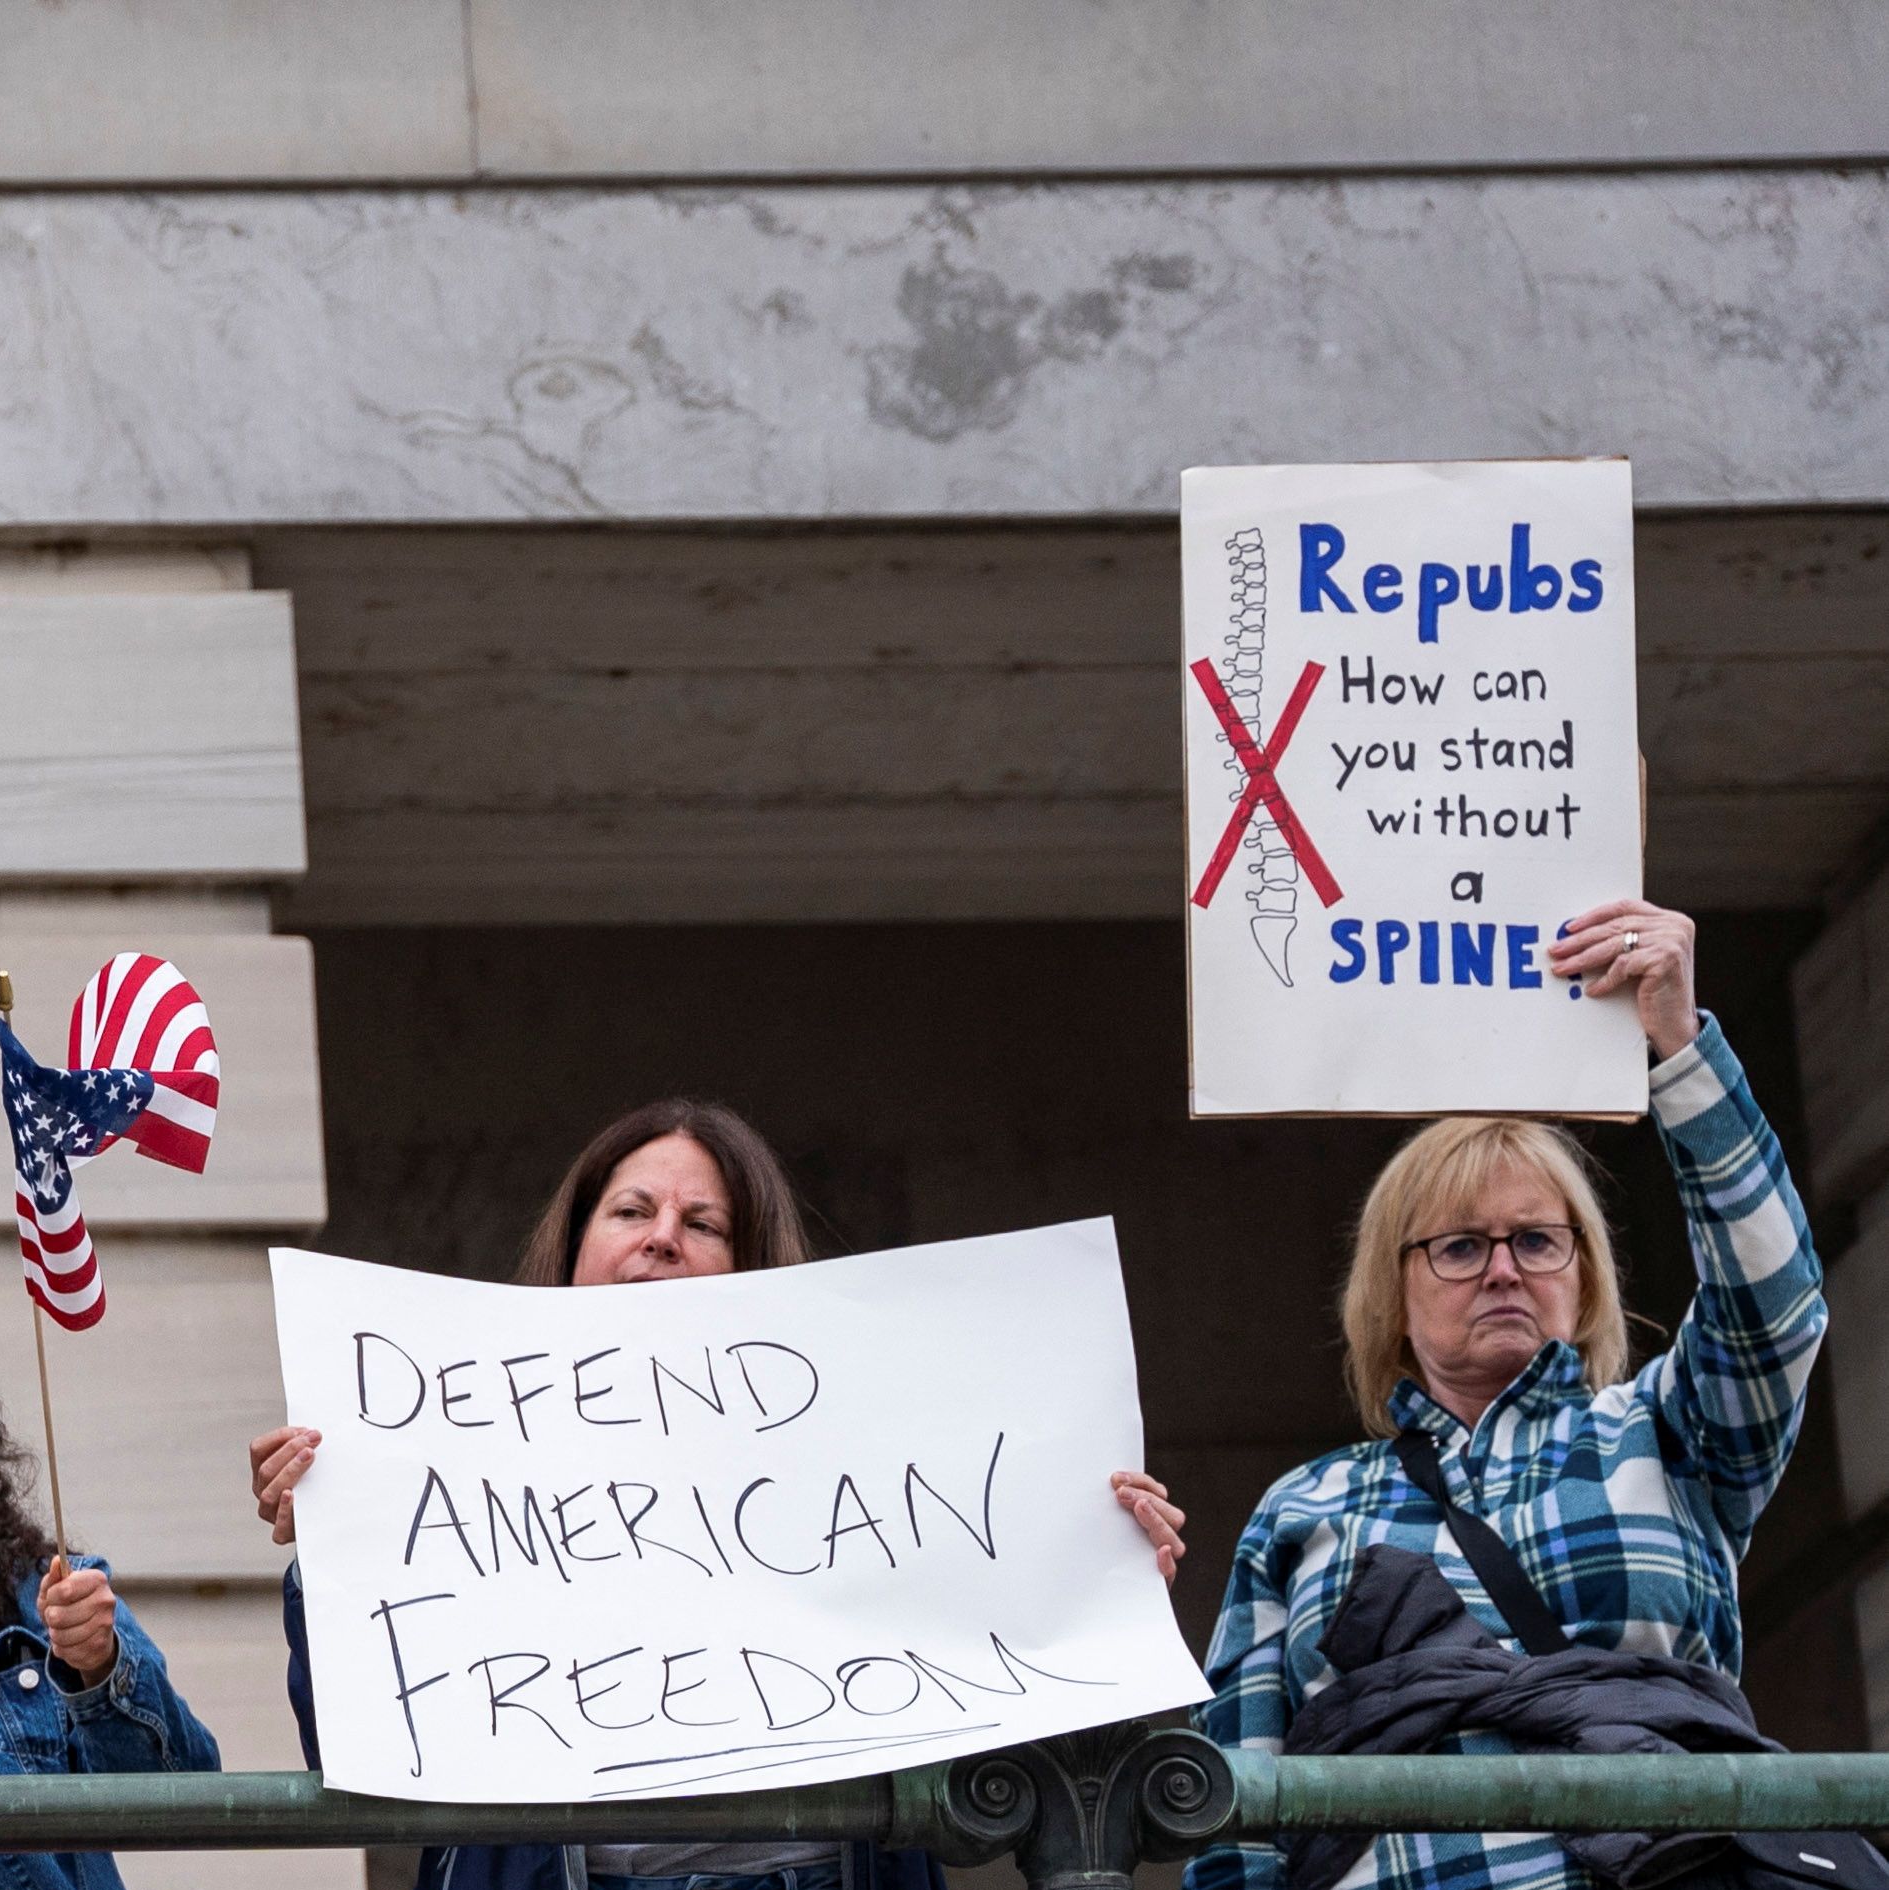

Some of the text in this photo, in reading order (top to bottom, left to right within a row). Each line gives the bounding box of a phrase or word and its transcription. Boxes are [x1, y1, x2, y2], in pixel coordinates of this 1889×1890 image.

[1299, 523, 1603, 643] Repubs
[1340, 655, 1547, 704] How can
[1331, 720, 1575, 791] you stand
[1366, 793, 1581, 839] without
[1450, 870, 1484, 902] a
[353, 1331, 819, 1441] DEFEND
[405, 1431, 1003, 1583] AMERICAN
[371, 1594, 1118, 1778] FREEDOM
